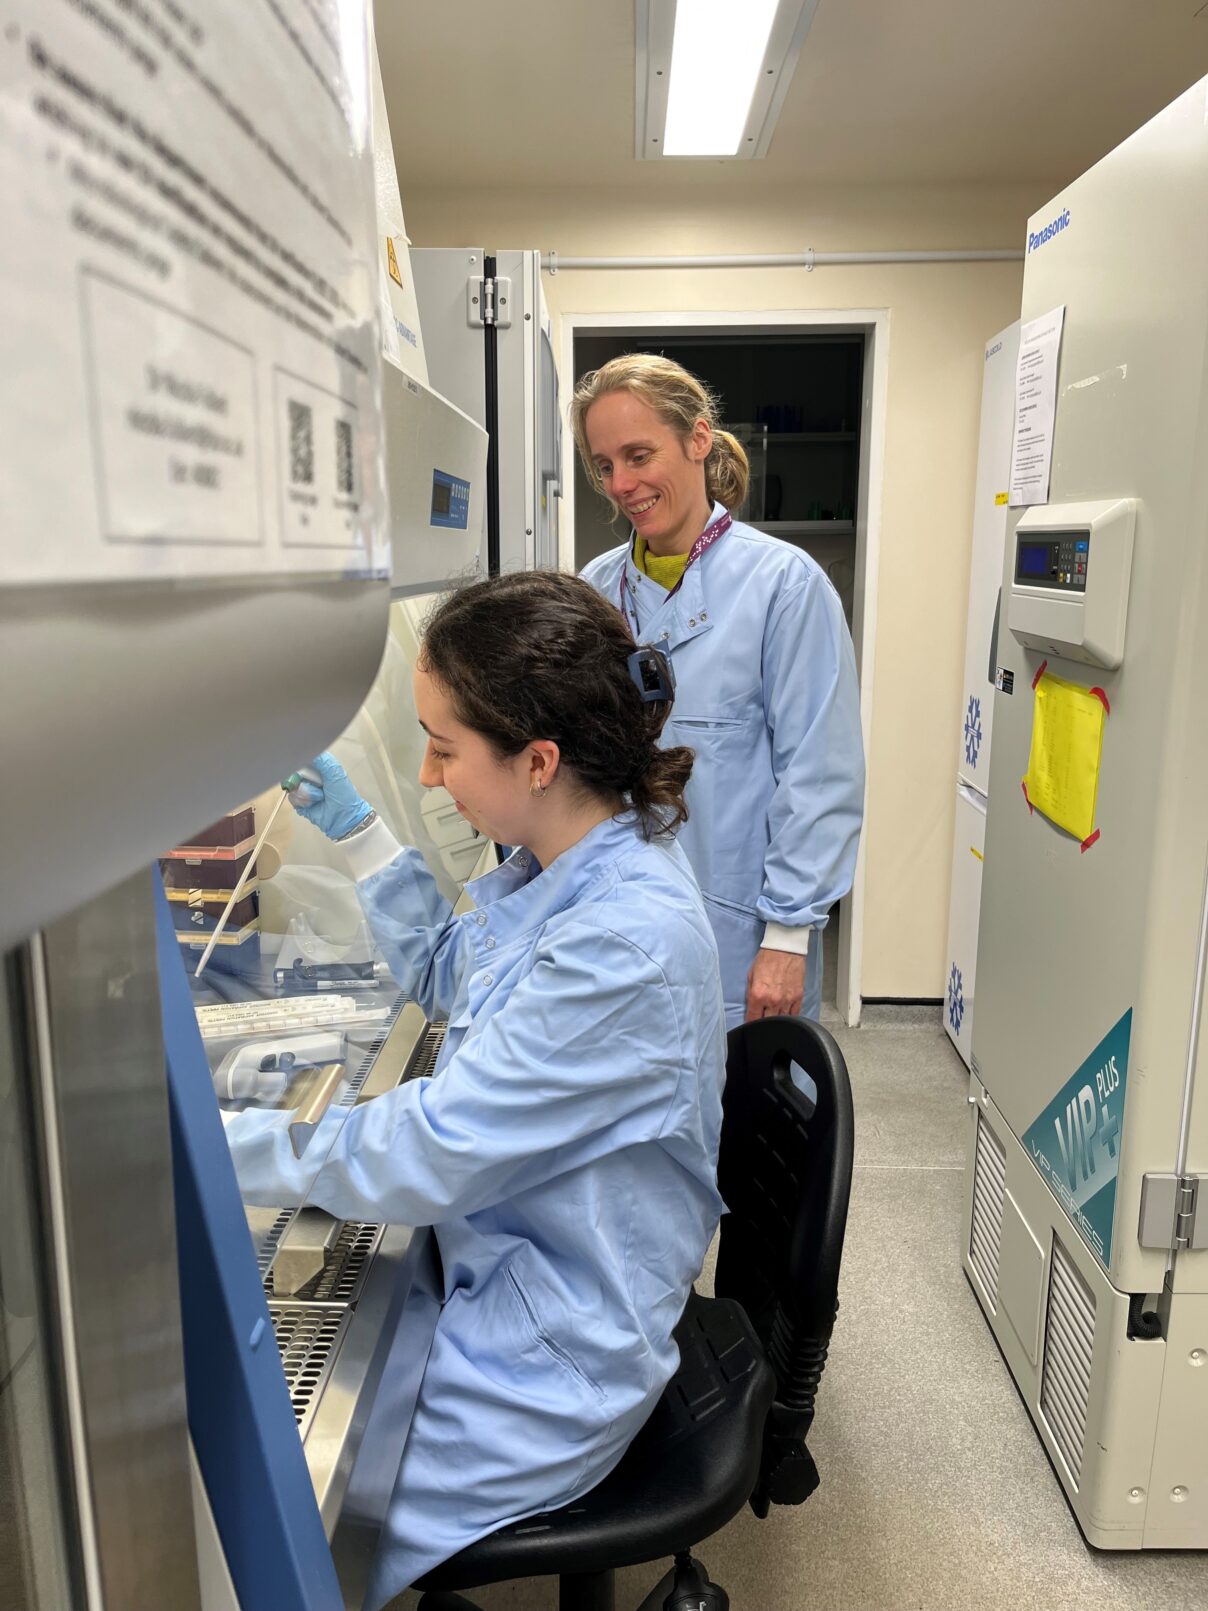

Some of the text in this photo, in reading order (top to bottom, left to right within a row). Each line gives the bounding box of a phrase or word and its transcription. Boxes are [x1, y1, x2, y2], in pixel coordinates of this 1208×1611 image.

[1028, 207, 1070, 254] Panasonic
[1096, 1055, 1120, 1102] PLUS
[1031, 1139, 1104, 1256] VIP SERIES
